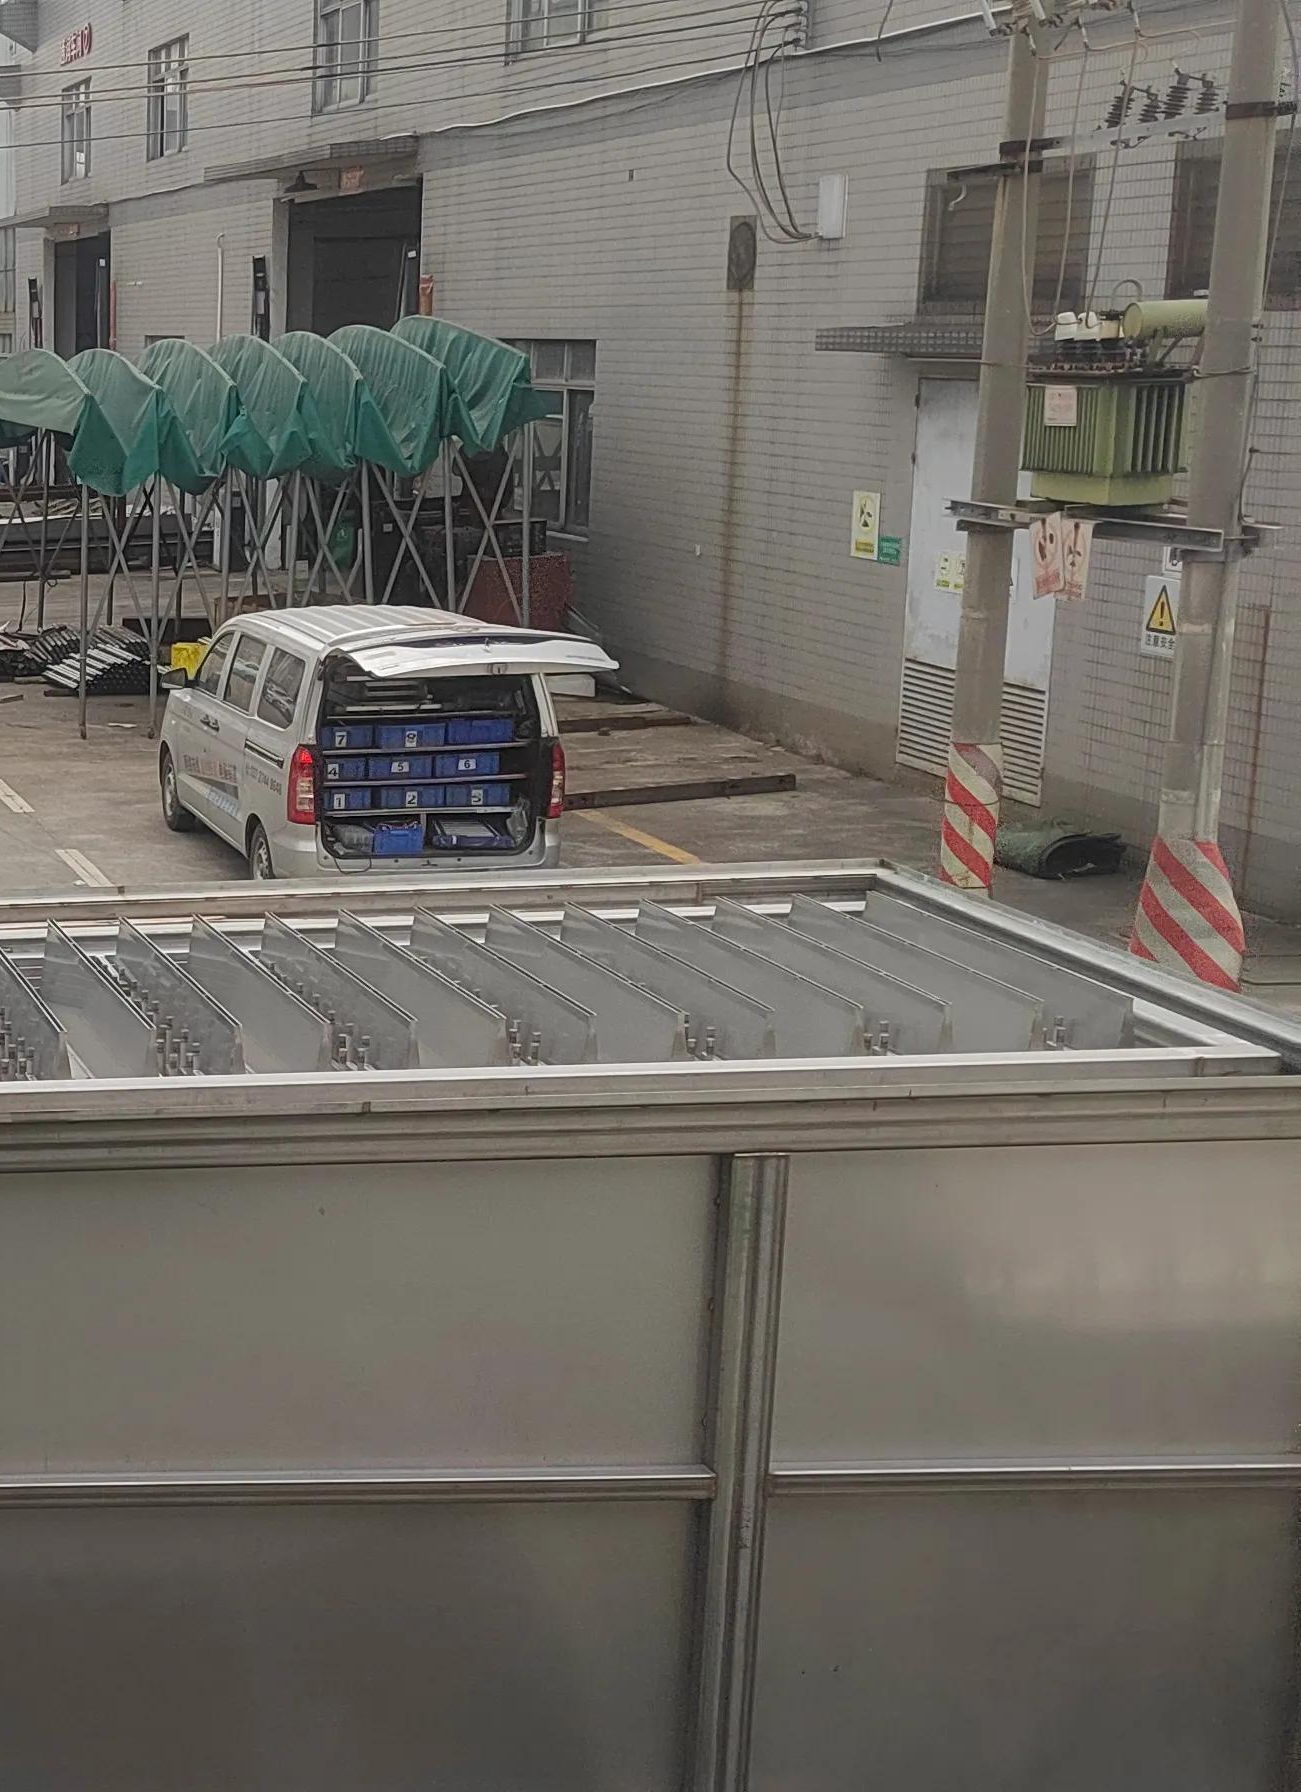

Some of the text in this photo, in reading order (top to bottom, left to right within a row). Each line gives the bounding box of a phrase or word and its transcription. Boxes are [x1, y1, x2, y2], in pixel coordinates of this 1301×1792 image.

[1144, 634, 1175, 650] 注意安全
[337, 735, 345, 745] 7
[397, 762, 404, 771] 5
[463, 759, 471, 769] 6
[328, 767, 338, 777] 4
[408, 793, 416, 804] 2
